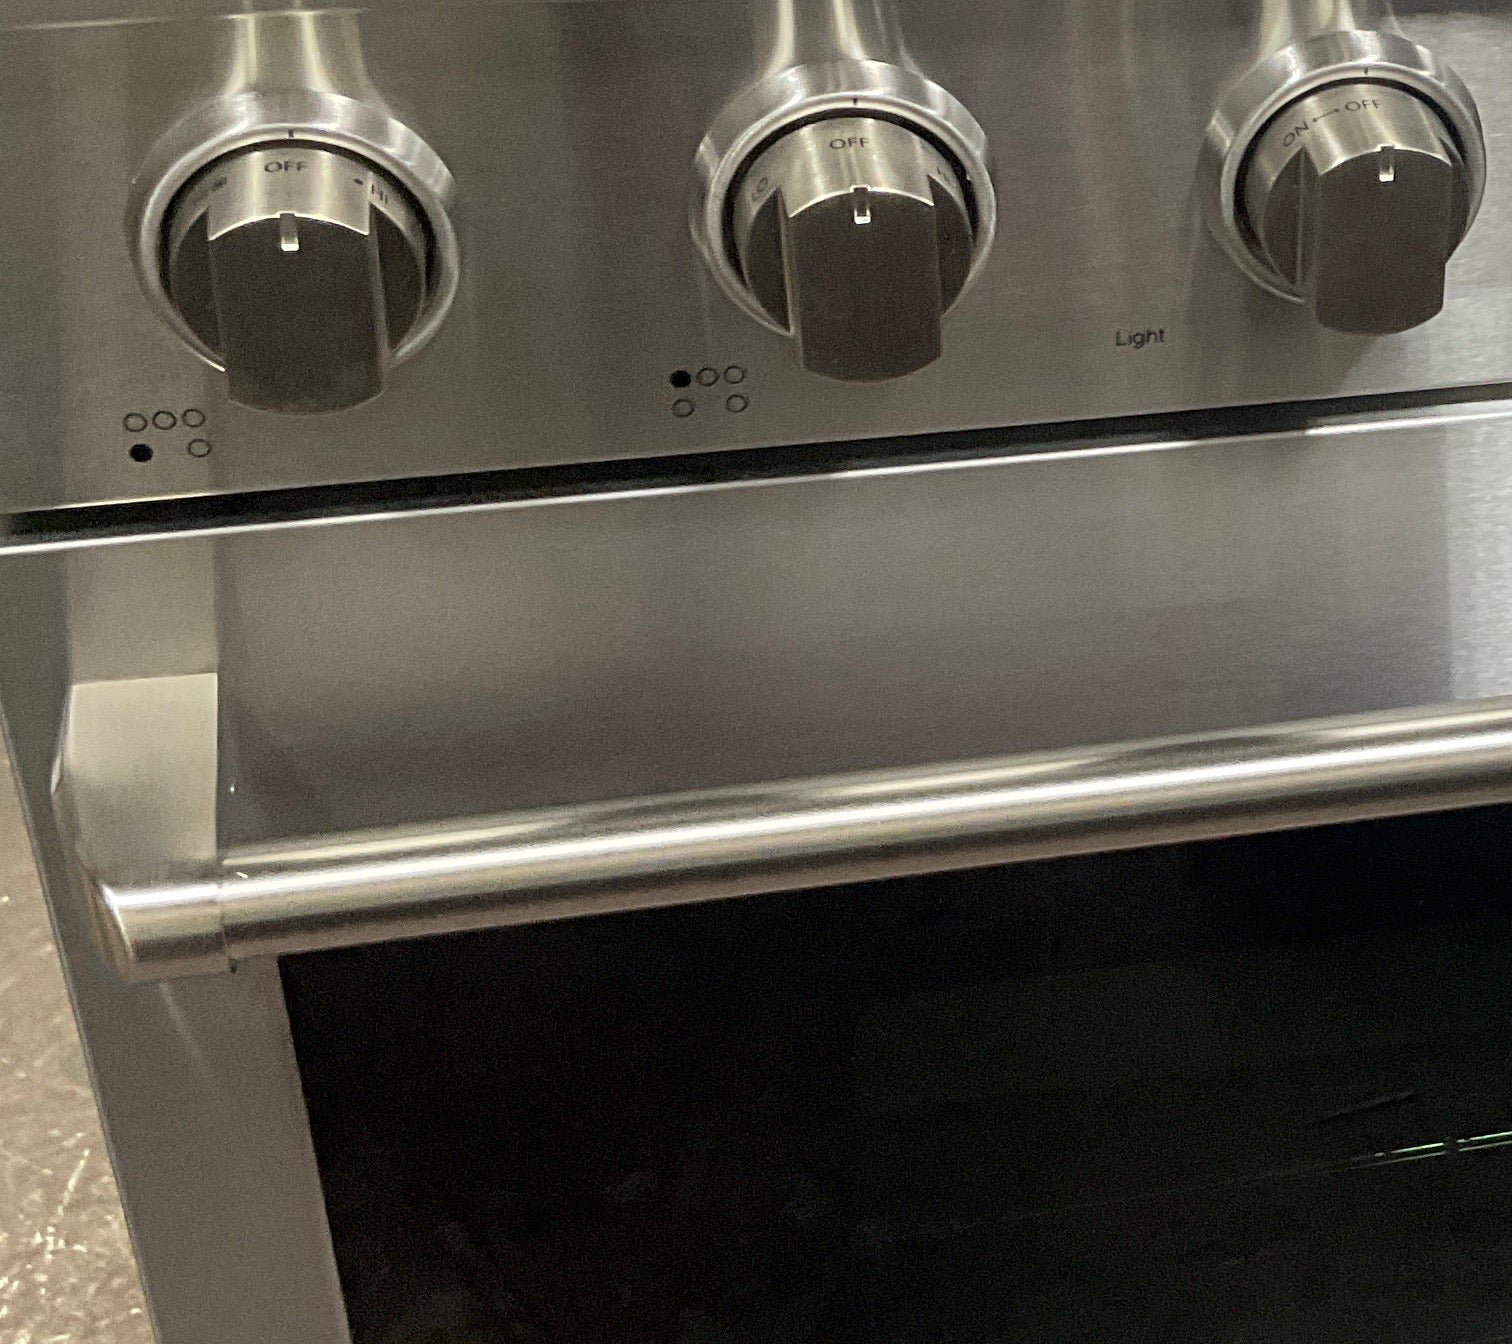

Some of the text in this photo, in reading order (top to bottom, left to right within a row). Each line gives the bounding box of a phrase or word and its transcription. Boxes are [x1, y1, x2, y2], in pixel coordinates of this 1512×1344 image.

[1282, 98, 1382, 148] ON OFF
[829, 137, 870, 150] OFF
[264, 160, 309, 173] OFF
[1114, 328, 1166, 349] Light
